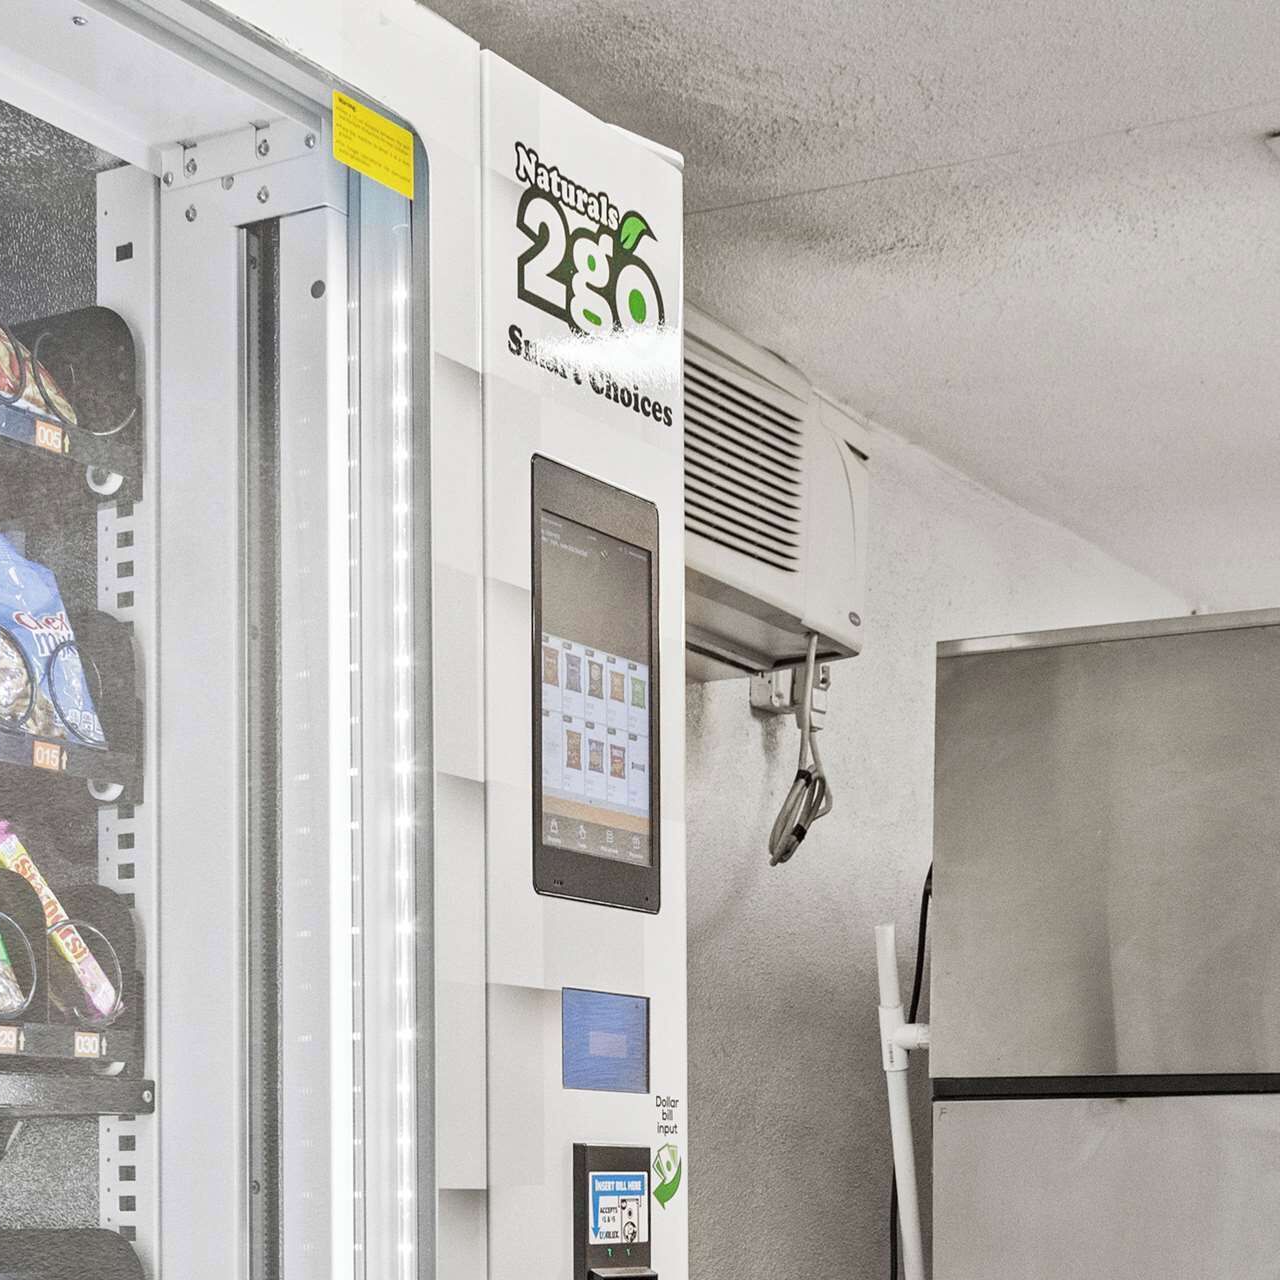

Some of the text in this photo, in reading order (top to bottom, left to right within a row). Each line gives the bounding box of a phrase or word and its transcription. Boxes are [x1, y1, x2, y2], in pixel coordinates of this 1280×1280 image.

[515, 142, 619, 230] Naturals
[517, 187, 665, 338] 2go
[588, 364, 674, 428] Choices
[36, 426, 63, 449] 005
[35, 744, 60, 769] 015
[76, 1034, 99, 1055] 030
[655, 1095, 680, 1111] Dollar
[661, 1109, 674, 1122] bill
[656, 1122, 679, 1136] input
[595, 1180, 616, 1192] INSERT
[600, 1206, 618, 1214] ACCEPTS
